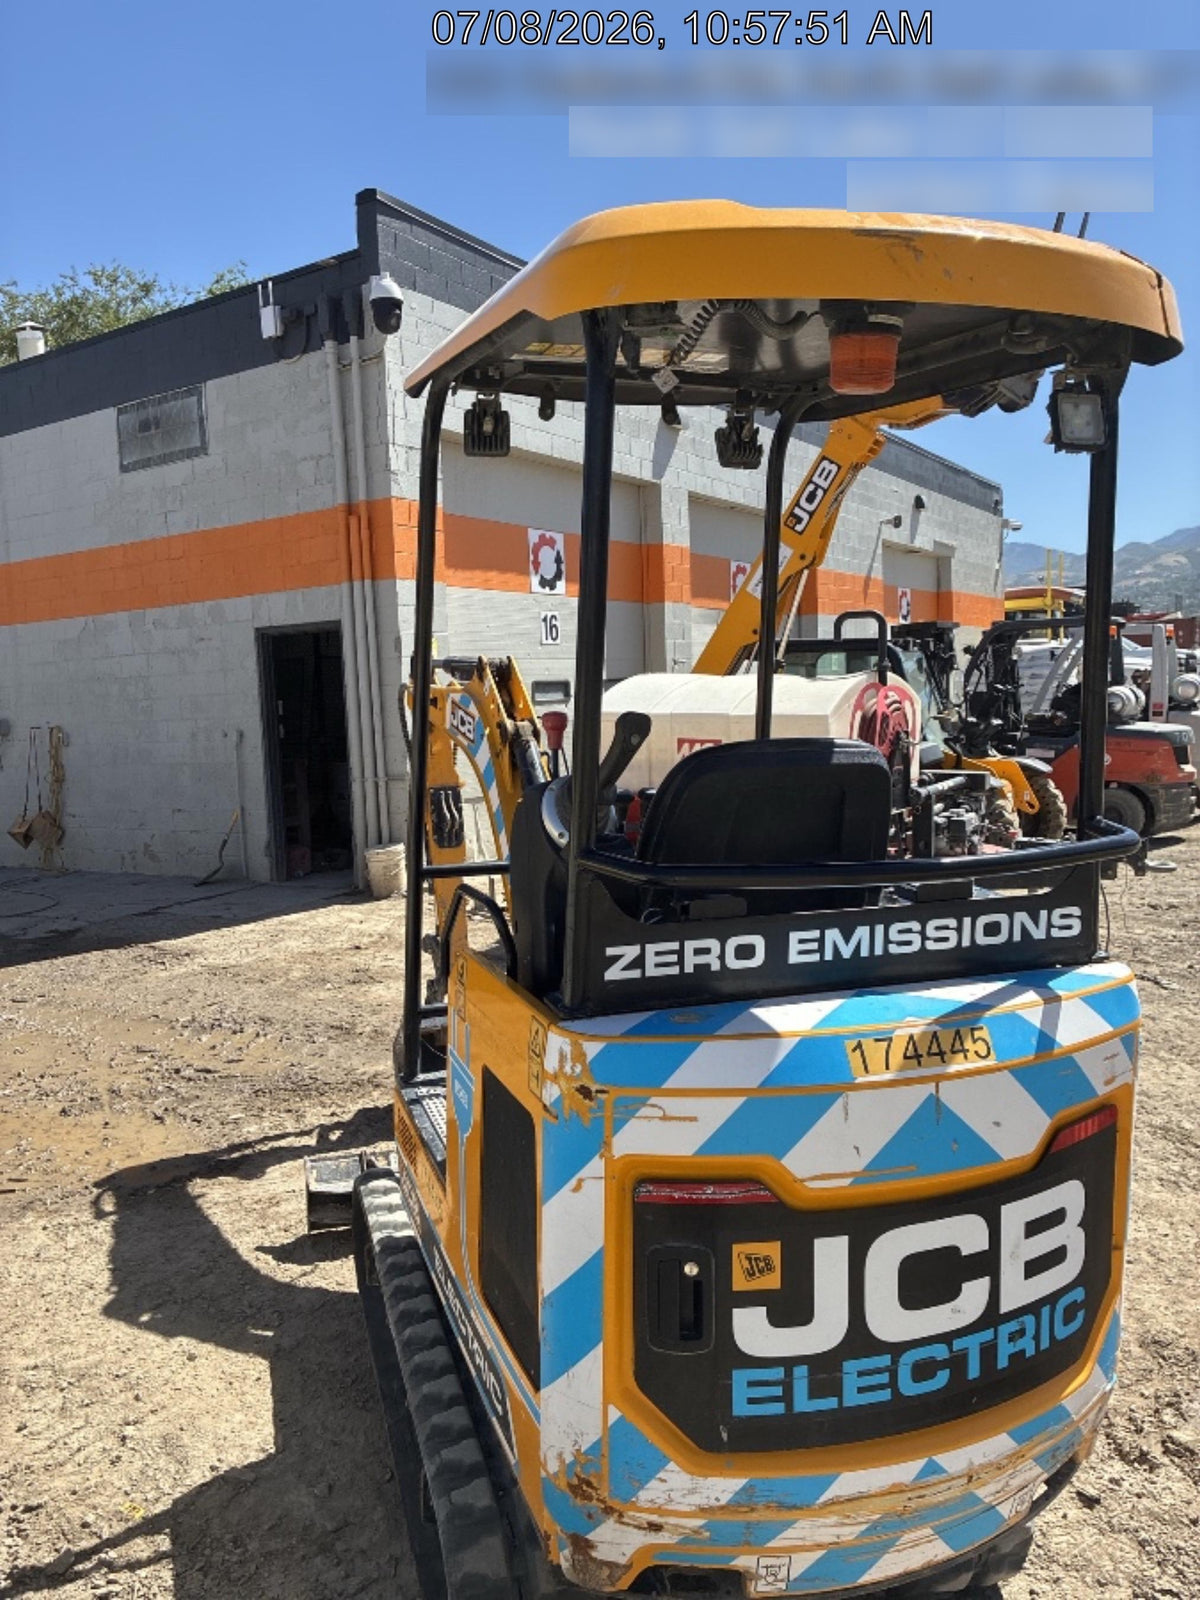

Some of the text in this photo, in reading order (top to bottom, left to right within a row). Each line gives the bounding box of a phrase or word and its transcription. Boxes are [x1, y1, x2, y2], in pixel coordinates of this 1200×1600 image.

[793, 459, 839, 533] JCB
[541, 613, 559, 642] 16
[450, 703, 475, 741] JCB
[604, 905, 1083, 982] ZERO EMISSIONS
[851, 1026, 992, 1074] 174445
[732, 1179, 1087, 1358] JCB
[744, 1253, 774, 1279] JCB
[732, 1286, 1086, 1418] ELECTRIC
